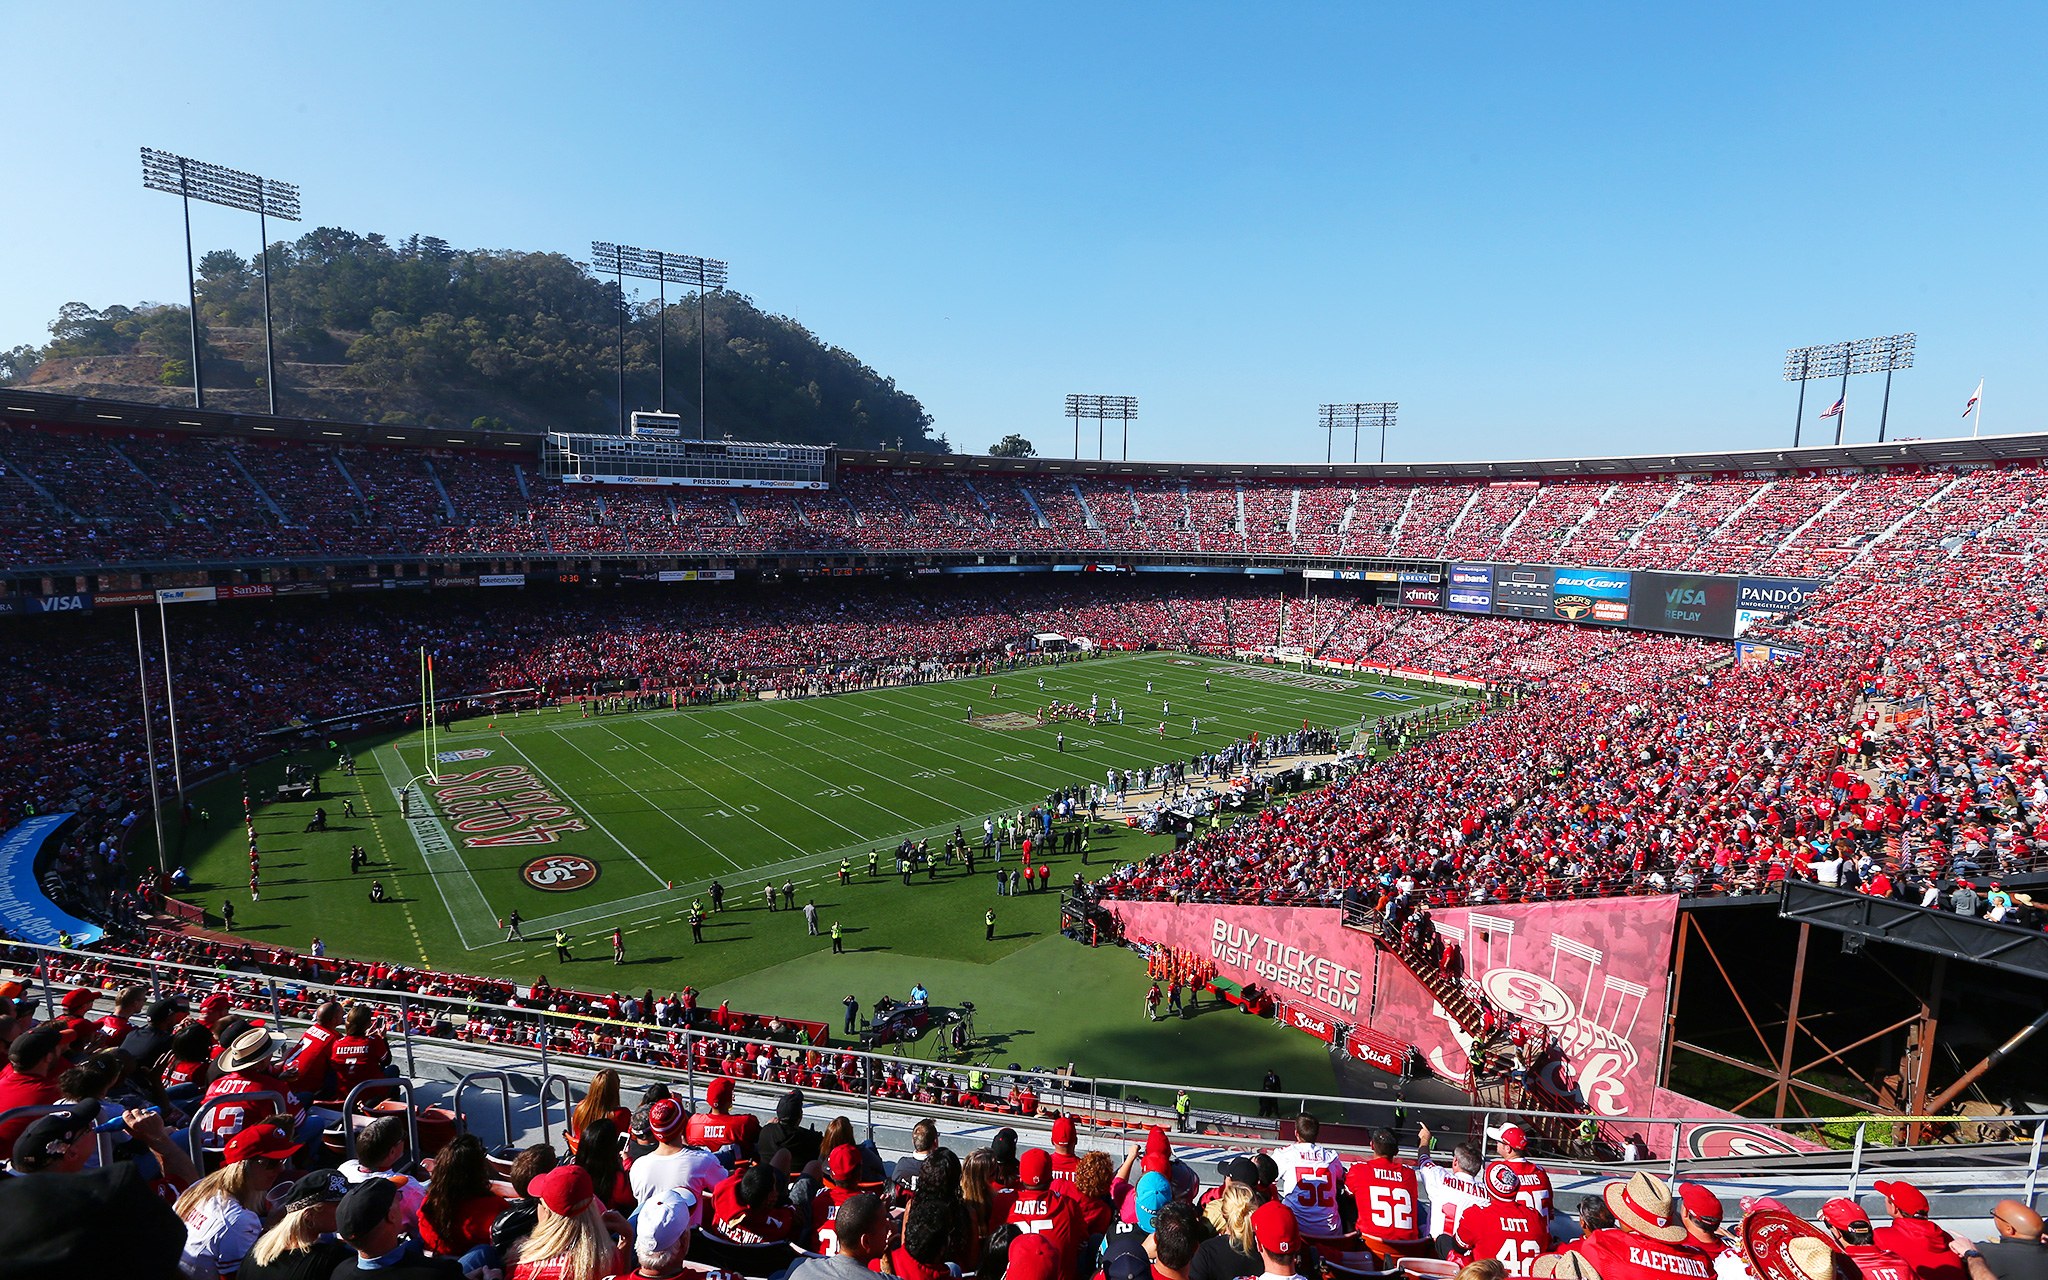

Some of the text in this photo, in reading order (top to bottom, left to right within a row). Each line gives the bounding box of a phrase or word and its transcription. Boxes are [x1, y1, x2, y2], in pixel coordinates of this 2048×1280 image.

[1825, 467, 1839, 475] 80
[692, 478, 731, 486] PRESSBOX
[559, 574, 580, 582] 12:30
[1340, 571, 1360, 580] VISA
[1555, 577, 1628, 589] BUD LIGHT
[232, 584, 272, 595] SanDisk
[1405, 589, 1440, 603] xfinity
[1665, 588, 1706, 606] VISA
[1741, 586, 1812, 605] PANDO
[38, 595, 83, 611] VISA
[1449, 594, 1490, 606] GEICO
[1553, 595, 1592, 606] KINDER'S
[1664, 609, 1701, 622] REPLAY
[412, 819, 448, 854] SERVICE
[3, 905, 36, 922] the
[17, 917, 60, 939] 49ers
[1212, 917, 1362, 996] BUY TICKETS
[1210, 939, 1358, 1016] VISIT 49ERS.COM
[1507, 976, 1558, 1018] SF
[1294, 1011, 1326, 1034] Stick
[286, 1038, 313, 1064] 7
[336, 1046, 369, 1054] KAEPERNICK
[1358, 1043, 1393, 1067] Stick
[345, 1058, 357, 1074] 7
[215, 1079, 252, 1094] LOTT
[703, 1125, 725, 1138] RICE
[1300, 1151, 1325, 1162] WILLIS
[1373, 1168, 1403, 1183] WILLIS
[1517, 1174, 1541, 1186] DAVIS
[1295, 1167, 1334, 1208] 52
[1443, 1177, 1490, 1201] MONTAN
[1014, 1200, 1048, 1215] DAVIS
[1368, 1185, 1413, 1230] 52
[1500, 1217, 1528, 1232] LOTT
[1495, 1238, 1540, 1278] 42
[1629, 1246, 1710, 1279] KAEPERNICK
